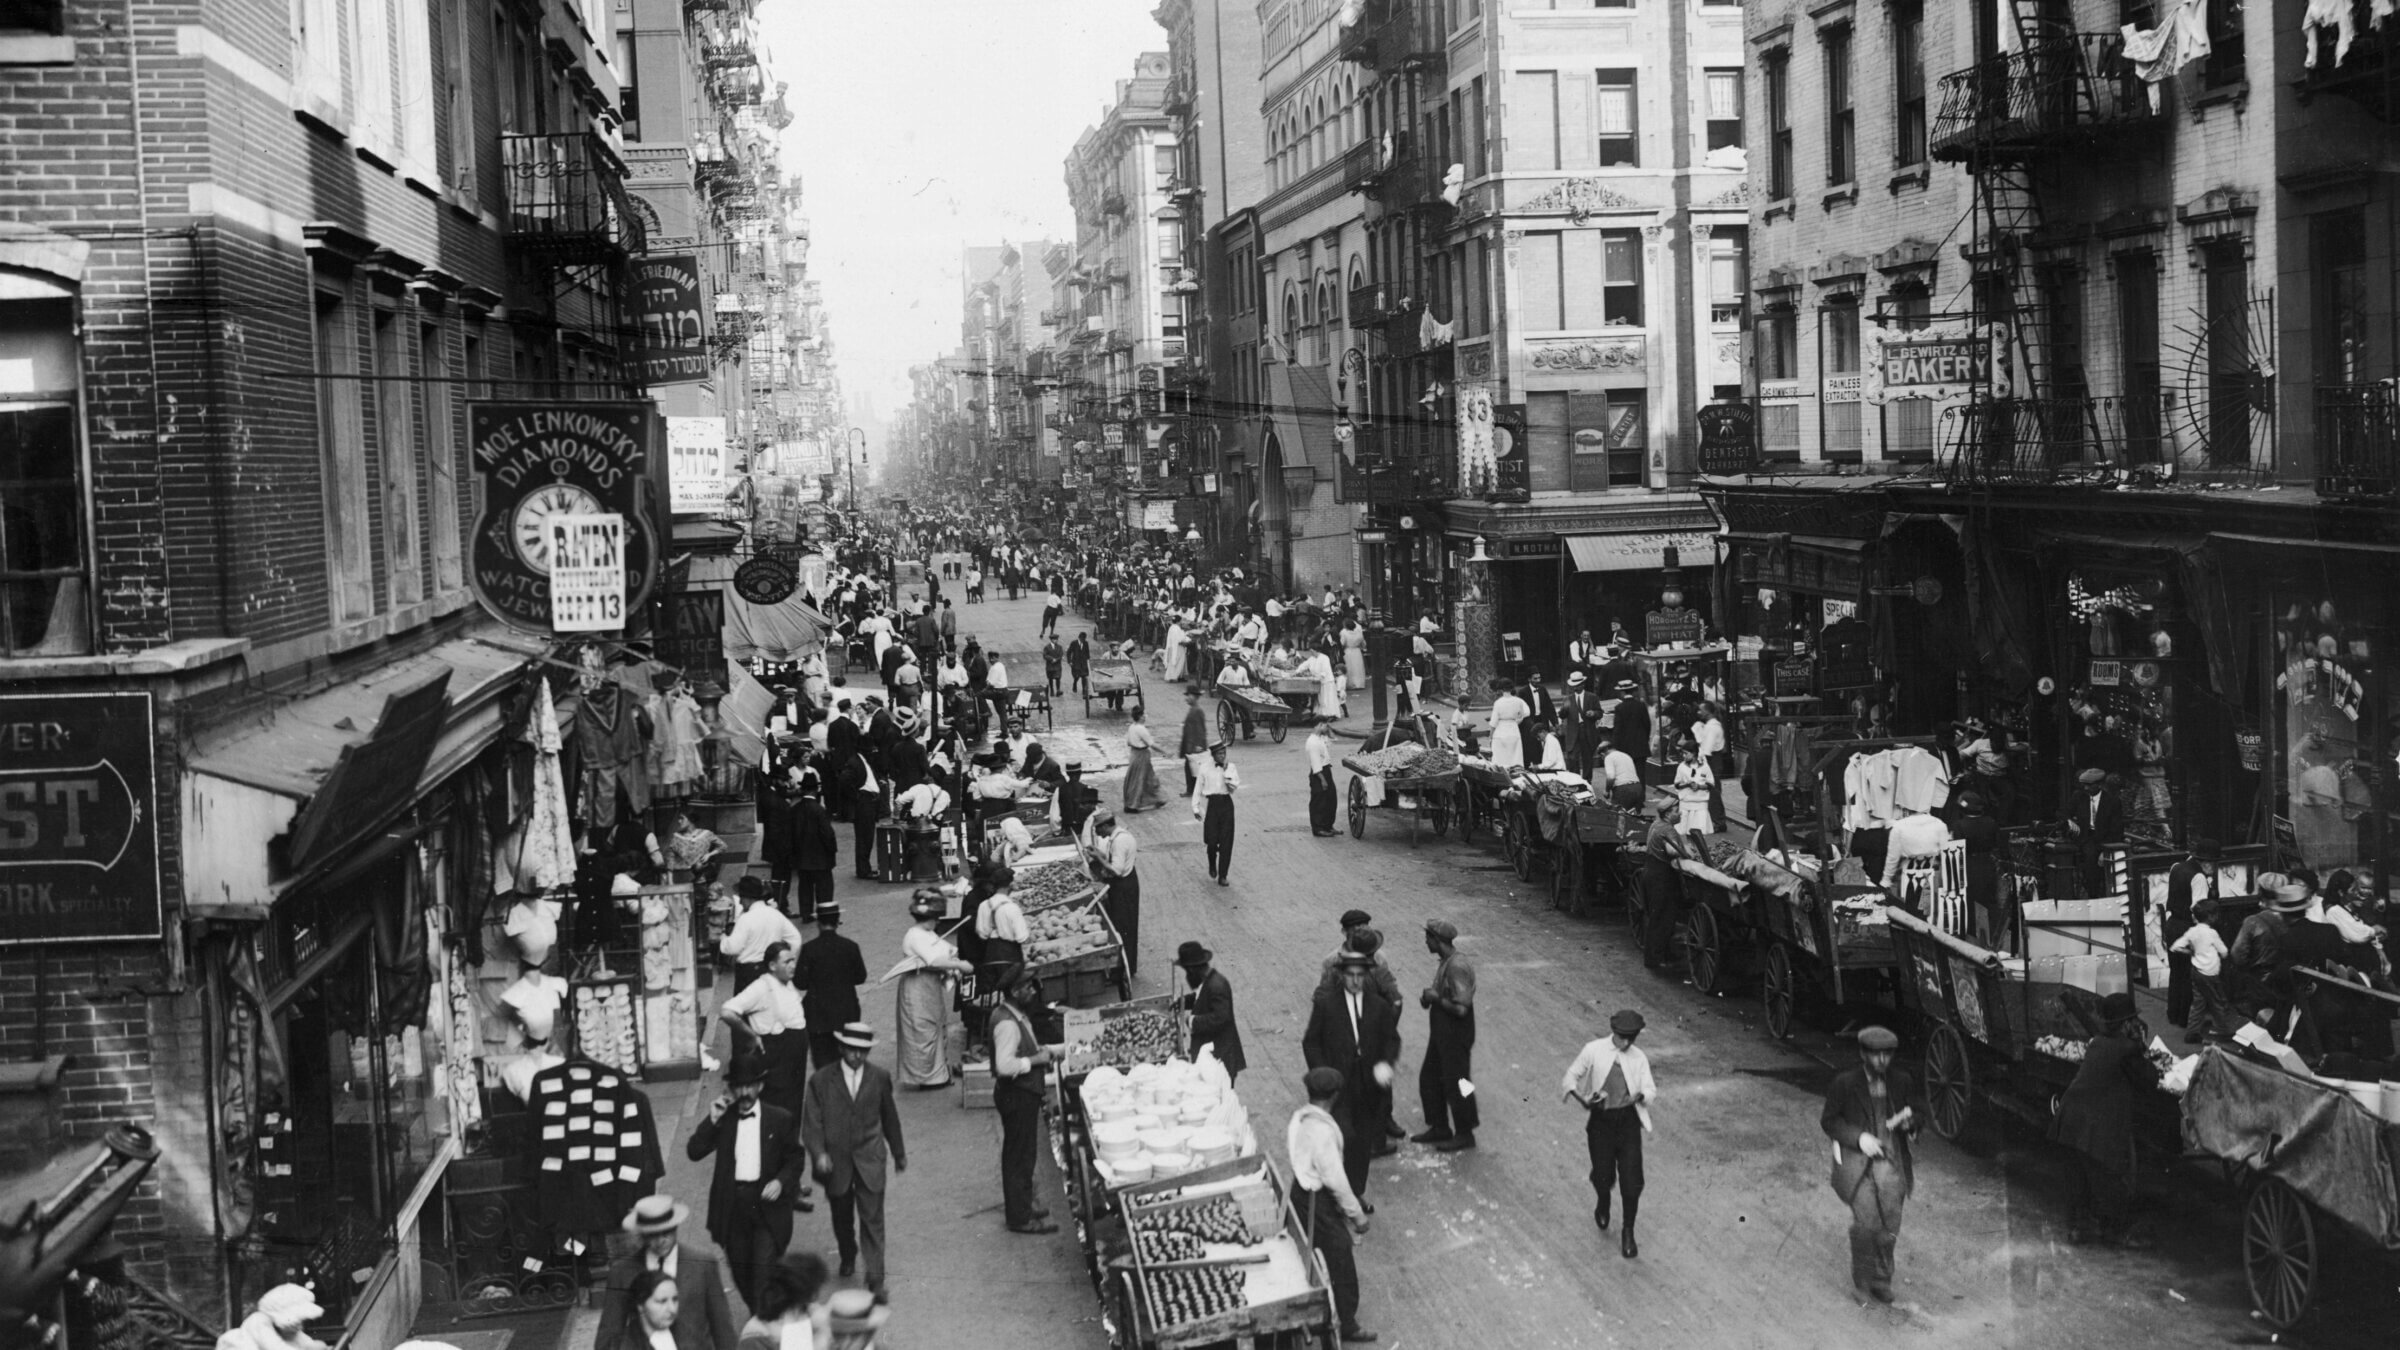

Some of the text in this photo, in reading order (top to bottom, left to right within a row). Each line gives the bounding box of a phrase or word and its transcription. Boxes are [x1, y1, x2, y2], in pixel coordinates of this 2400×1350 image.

[1901, 345, 1957, 358] GEWIRTZ
[1960, 345, 1969, 355] &
[1887, 355, 1988, 384] BAKERY
[1829, 378, 1861, 389] PAINLESS
[1612, 412, 1635, 442] DENTIST
[475, 423, 520, 465] MOE
[1704, 446, 1750, 459] DENTIST
[1620, 546, 1688, 555] CARPS
[599, 594, 621, 620] 13
[655, 596, 721, 634] LAW
[1670, 631, 1694, 639] HAT
[1776, 665, 1810, 677] THIS CASE
[2092, 663, 2119, 677] ROOMS
